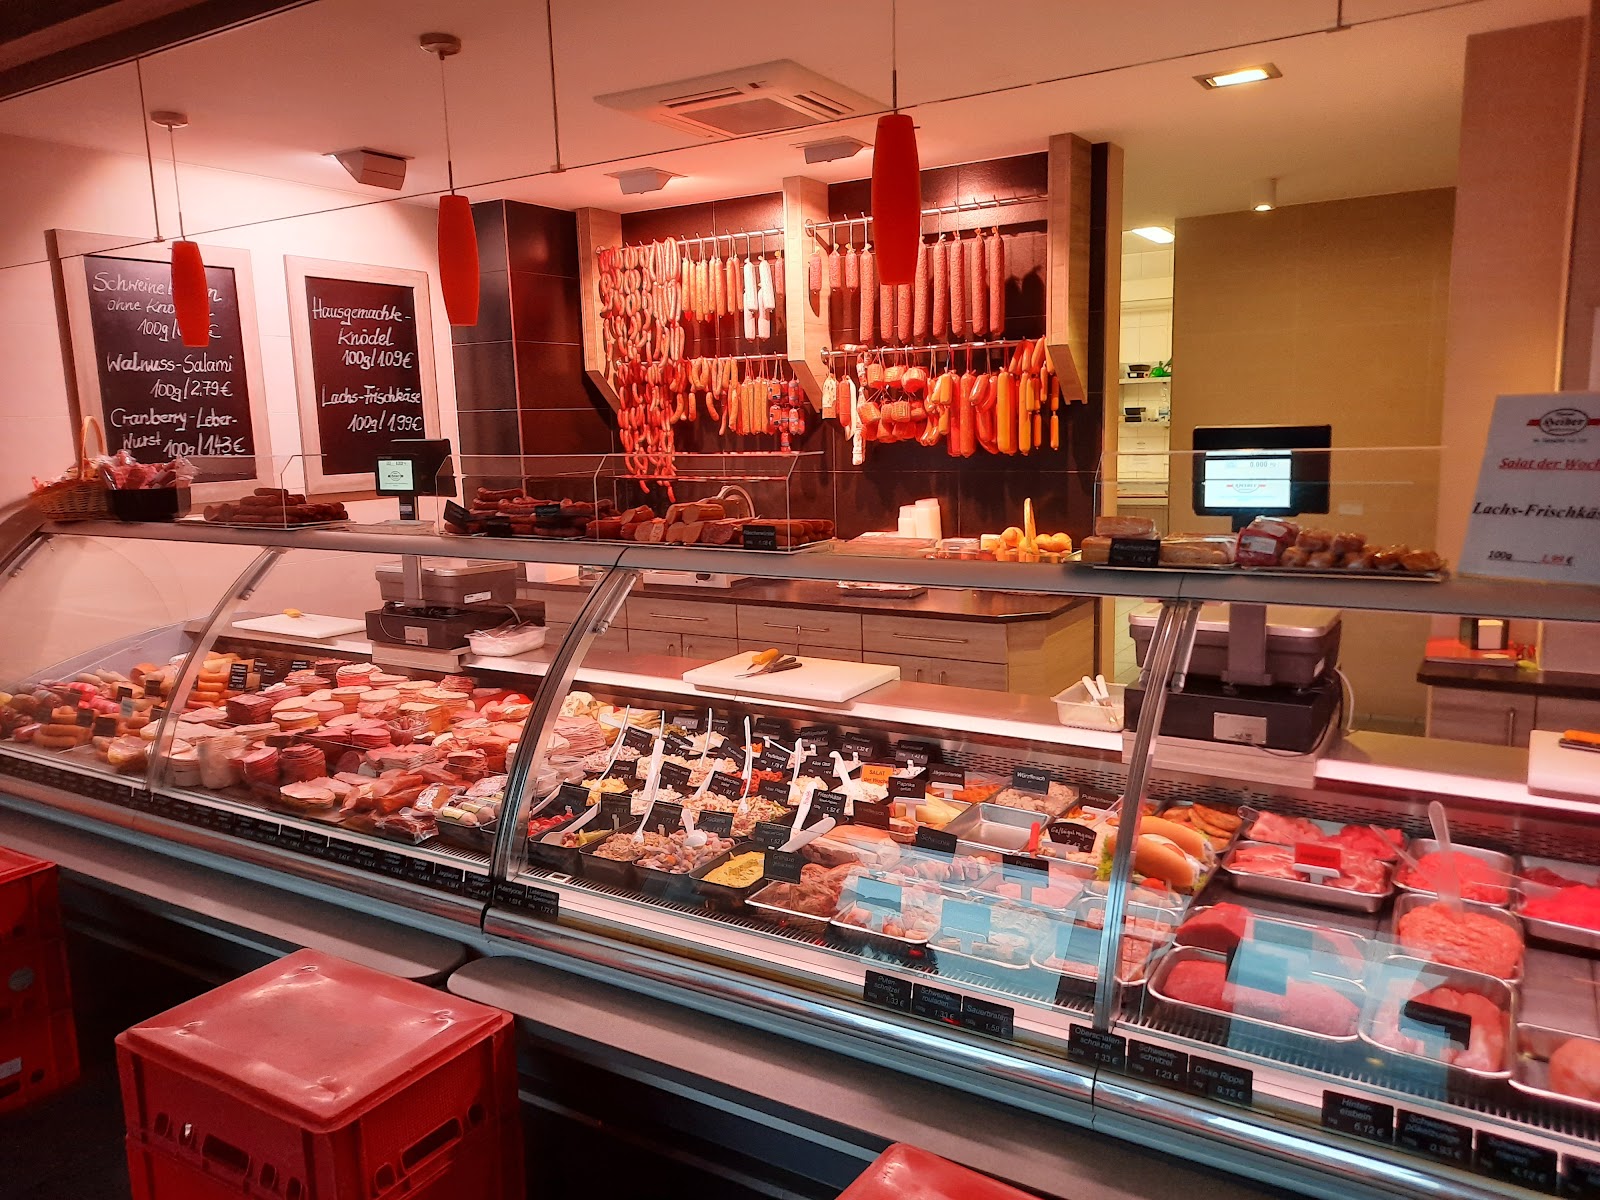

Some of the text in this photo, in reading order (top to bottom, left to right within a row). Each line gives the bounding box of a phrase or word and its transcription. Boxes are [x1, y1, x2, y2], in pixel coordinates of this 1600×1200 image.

[107, 299, 142, 311] ohne
[338, 327, 395, 347] Knödel
[322, 384, 421, 407] Lachs-Frischkäse
[1499, 457, 1536, 470] Salat
[1537, 458, 1562, 470] der
[869, 769, 886, 777] SALAT
[885, 995, 899, 1006] 1.33
[934, 1009, 949, 1019] 1.33
[966, 1004, 1010, 1022] Sauerbraten
[1139, 1052, 1173, 1067] schnitzel
[1155, 1068, 1172, 1080] 1.23
[1195, 1064, 1245, 1087] Dicke Rippe
